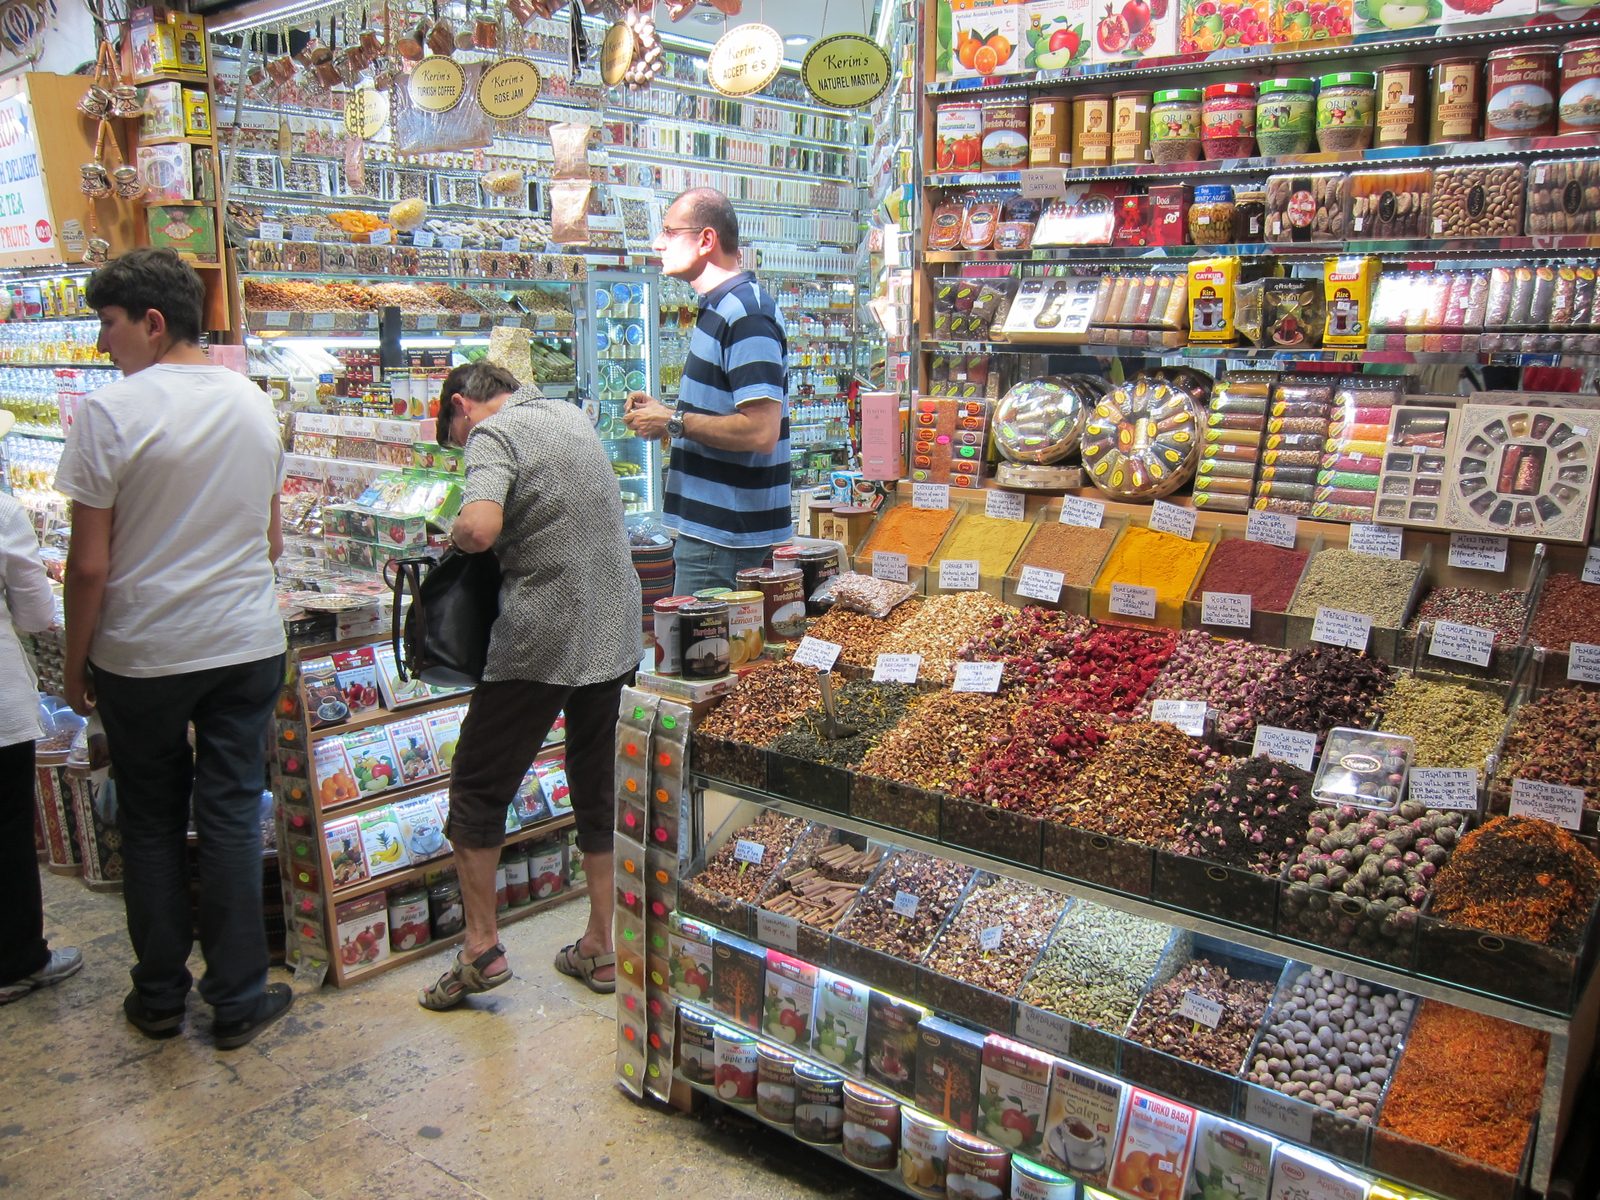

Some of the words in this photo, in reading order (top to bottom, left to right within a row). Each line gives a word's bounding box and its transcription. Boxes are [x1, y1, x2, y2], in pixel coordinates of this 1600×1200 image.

[824, 53, 869, 70] Kerim's
[422, 69, 451, 82] Kerim's
[723, 65, 748, 80] ACCEPT
[492, 72, 525, 88] Kerim's
[818, 78, 850, 92] NATUREL
[851, 74, 881, 88] MASTICA
[416, 86, 437, 97] TURKISH
[438, 85, 457, 97] COFFEE
[494, 91, 511, 104] ROSE
[511, 89, 525, 101] JAM
[6, 153, 39, 183] DELIGHT
[1029, 183, 1057, 191] SAFFRON
[6, 191, 25, 214] TEA
[1228, 598, 1242, 606] TEA
[731, 615, 753, 625] Lemon
[1475, 630, 1488, 638] TEA
[1257, 739, 1272, 748] TEA
[1291, 735, 1313, 747] BLACK
[1268, 748, 1284, 758] ROSE
[1285, 751, 1299, 759] TEA
[1453, 771, 1469, 779] TEA
[1411, 780, 1424, 788] YOU
[1457, 780, 1471, 788] THE
[1410, 787, 1425, 795] TEA
[1514, 791, 1531, 800] TEA
[1550, 786, 1573, 798] BLACK
[720, 1052, 743, 1065] Apple
[744, 1053, 757, 1064] Tea
[1002, 1055, 1016, 1065] TURKO
[1015, 1059, 1027, 1069] BABA
[1071, 1070, 1096, 1091] TURKO
[1096, 1080, 1118, 1099] BABA
[1063, 1098, 1100, 1126] Salep
[1147, 1100, 1170, 1118] TURKO
[1170, 1108, 1190, 1126] BABA
[1242, 1159, 1269, 1176] Apple
[1316, 1176, 1339, 1194] Apple
[1341, 1186, 1357, 1200] Tea
